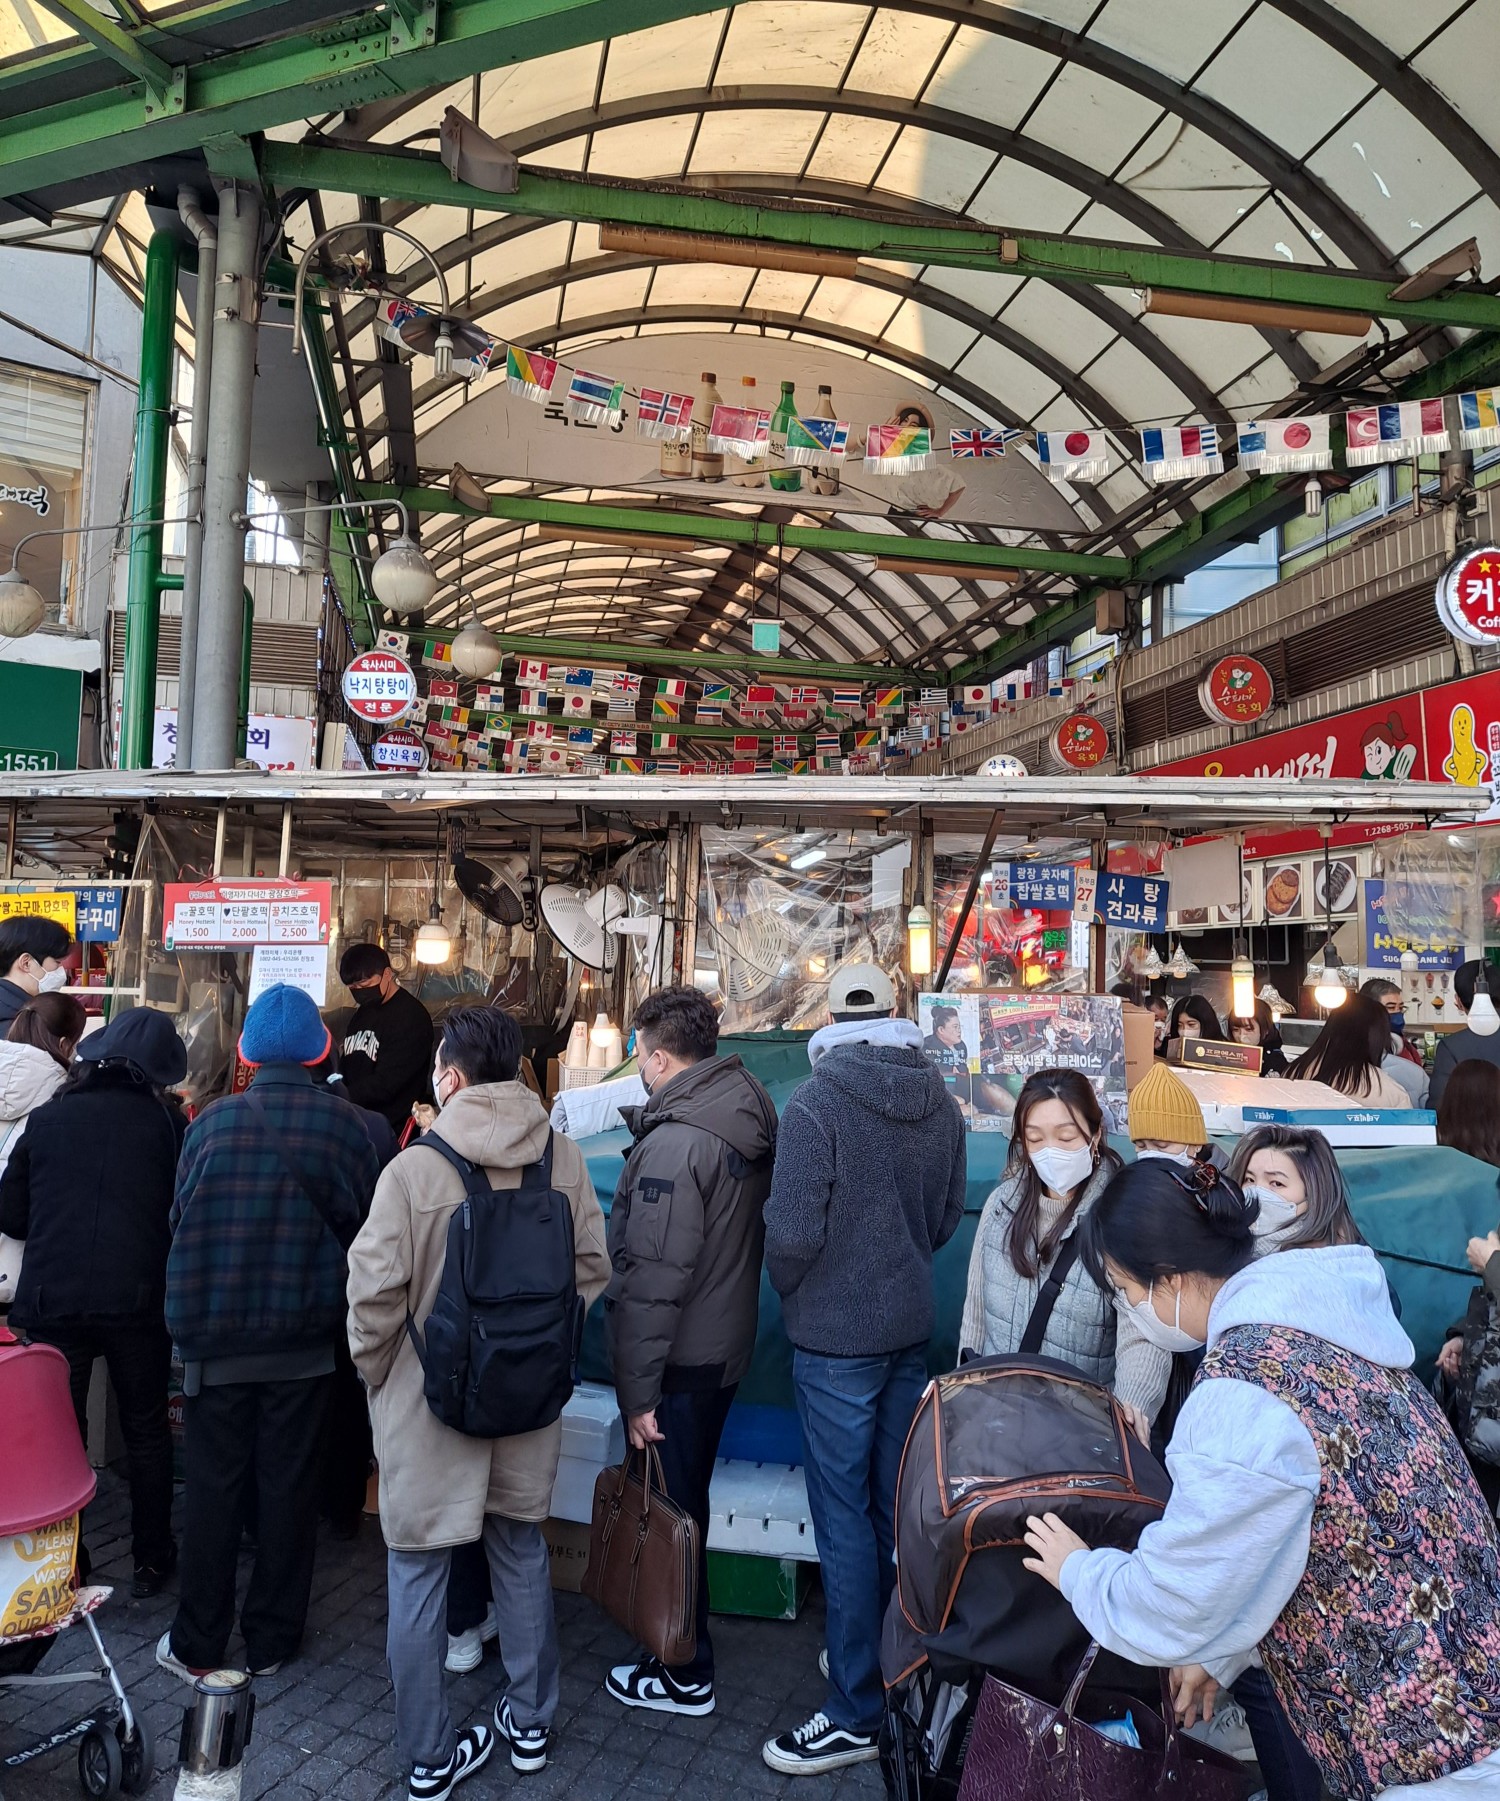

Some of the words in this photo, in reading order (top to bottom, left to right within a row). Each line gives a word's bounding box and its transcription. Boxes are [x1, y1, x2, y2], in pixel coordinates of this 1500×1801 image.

[1466, 577, 1500, 612] 커
[361, 660, 396, 671] 육사시미
[350, 677, 408, 694] 낙지탕탕이
[1236, 702, 1262, 714] 육회
[378, 748, 421, 762] 창신육회
[1017, 867, 1036, 880] 광장
[97, 891, 115, 902] 달인
[1017, 882, 1070, 901] 찹쌀호떡
[1077, 887, 1092, 901] 27
[272, 906, 318, 917] 꿀치즈호떡
[1081, 903, 1089, 912] 호
[1106, 900, 1158, 926] 견과류
[185, 928, 209, 938] 1,500
[232, 928, 257, 938] 2,000
[281, 927, 307, 938] 2,500
[1003, 1053, 1043, 1067] 광장시장
[1057, 1055, 1102, 1068] 플레이스
[527, 1729, 542, 1737] NIKE
[414, 1766, 427, 1776] NIKE
